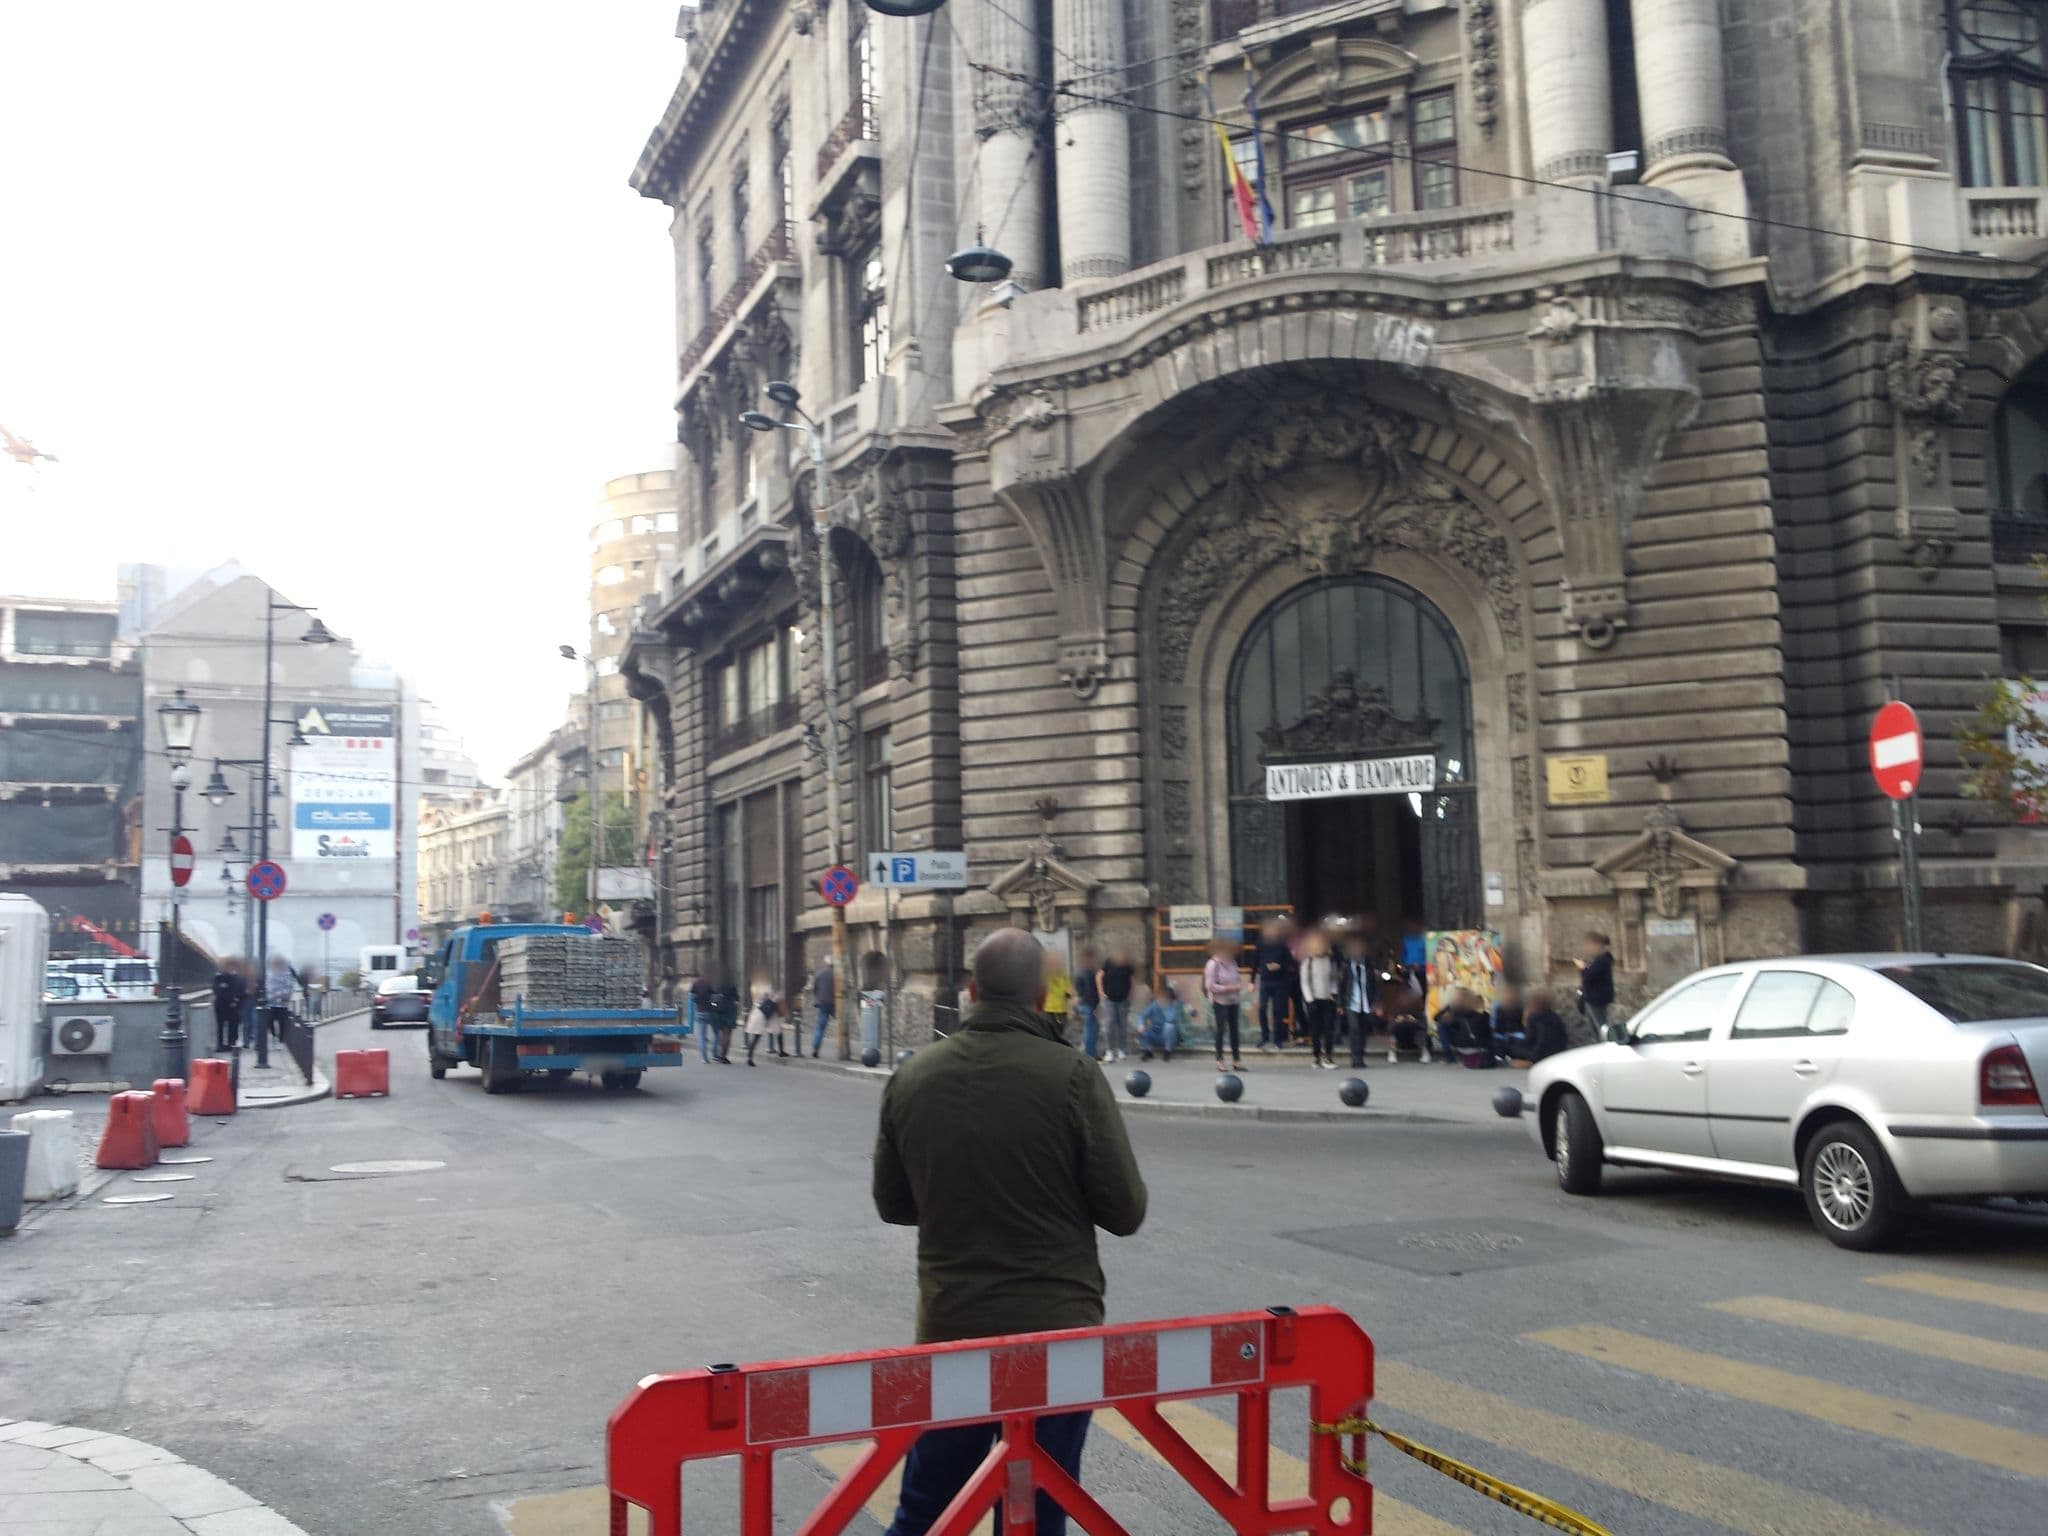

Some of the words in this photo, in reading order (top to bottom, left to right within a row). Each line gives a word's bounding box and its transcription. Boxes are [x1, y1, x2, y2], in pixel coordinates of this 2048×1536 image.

[1270, 765, 1334, 795] ANTIQUES
[1338, 763, 1350, 790] &
[1354, 759, 1434, 790] HANDMADE
